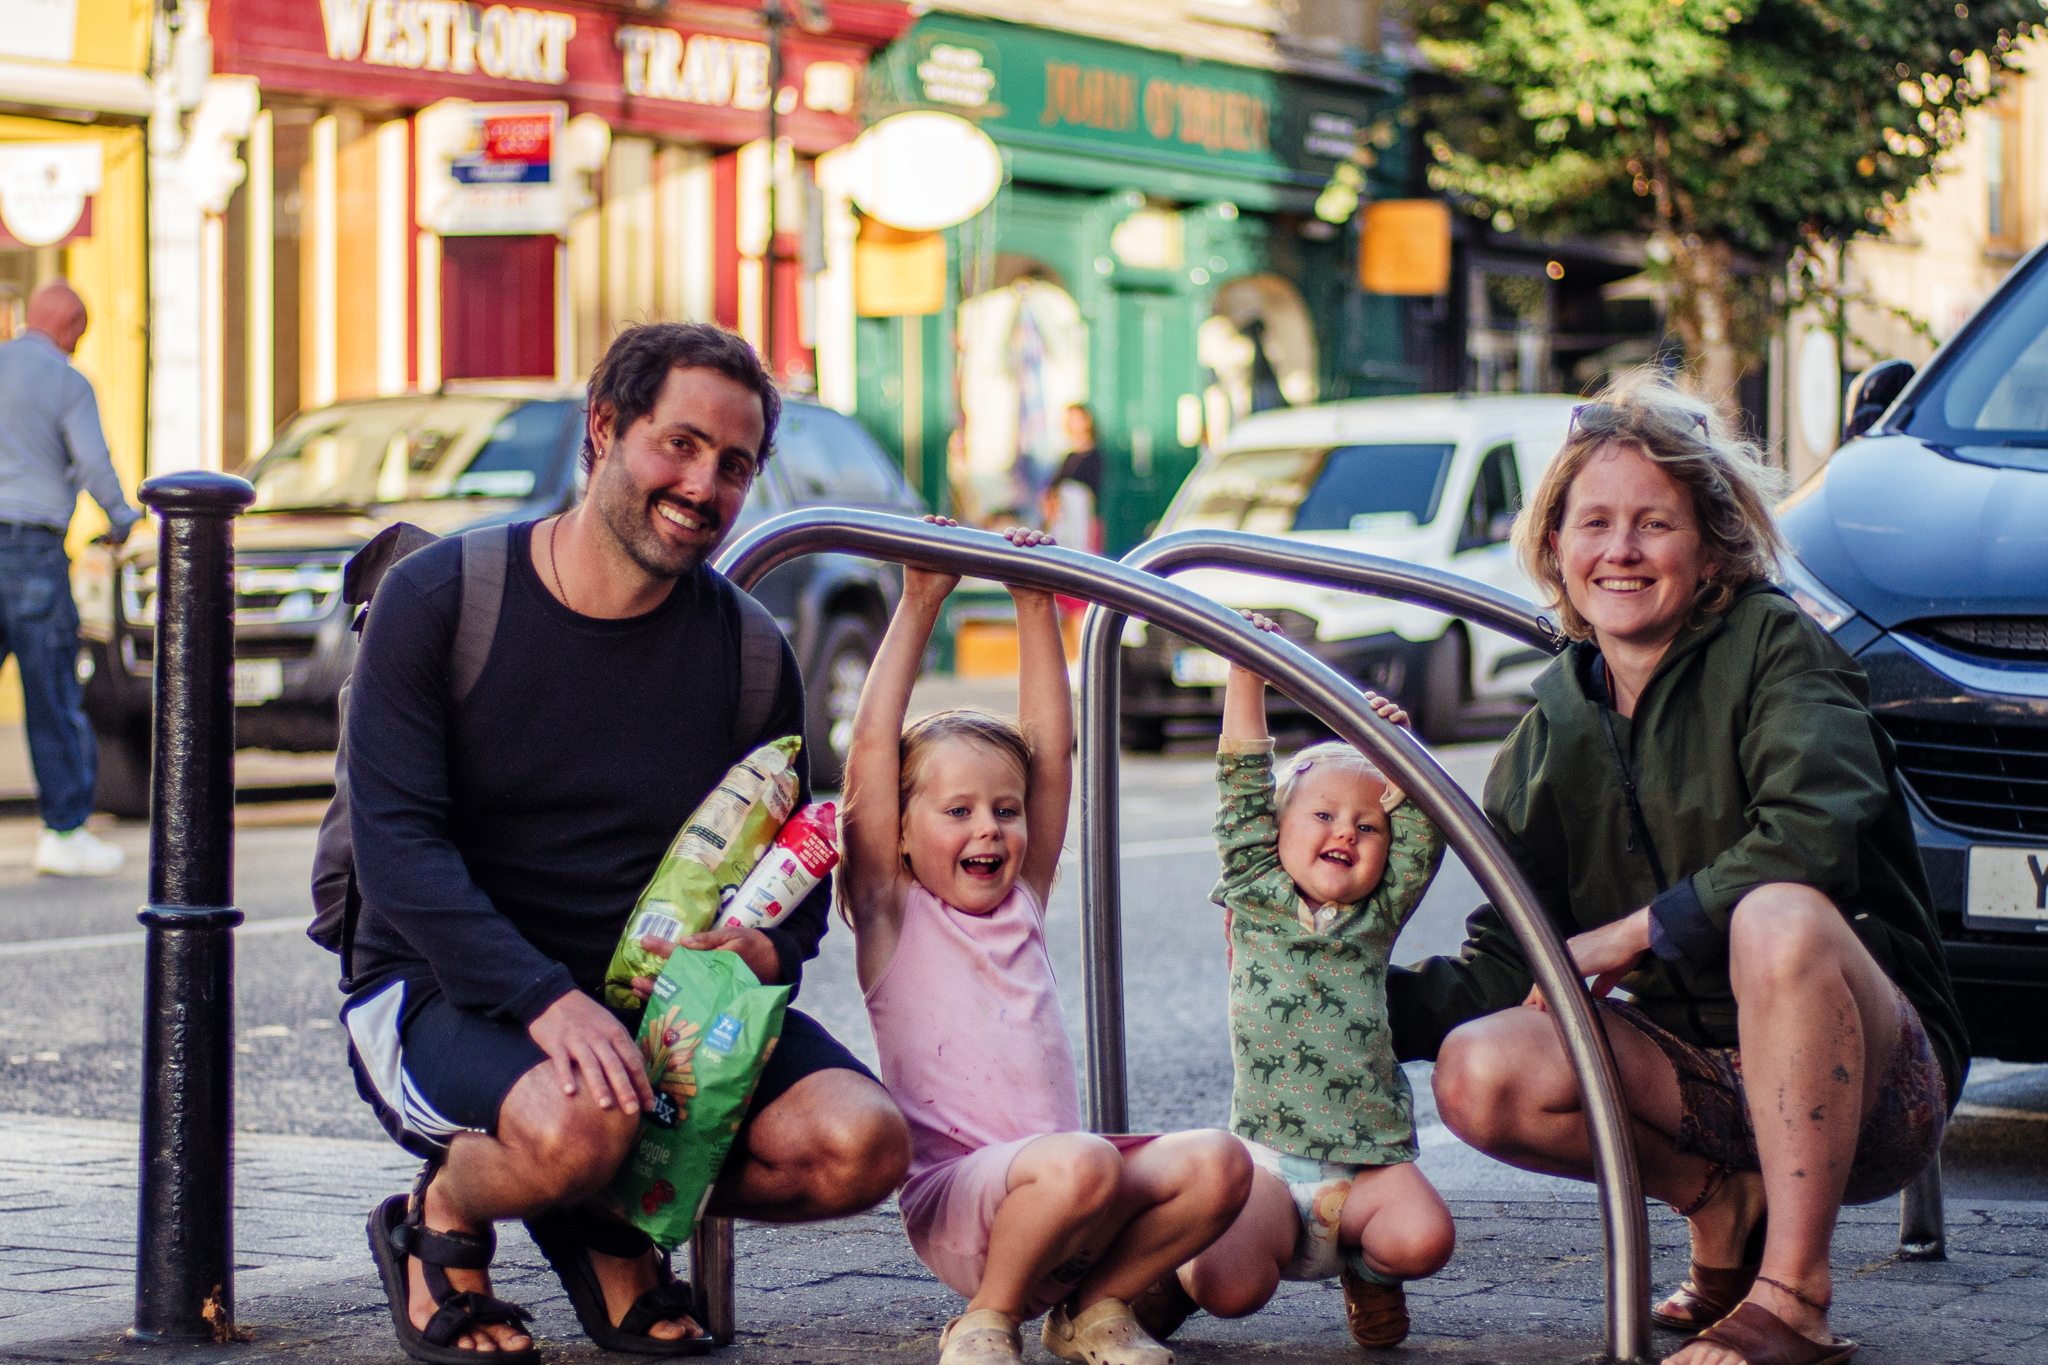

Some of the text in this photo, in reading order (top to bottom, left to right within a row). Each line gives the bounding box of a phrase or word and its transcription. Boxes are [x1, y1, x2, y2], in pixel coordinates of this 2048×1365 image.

[614, 24, 798, 115] TRAVE
[802, 840, 811, 848] GOT
[811, 832, 819, 840] FOR
[2027, 855, 2048, 909] Y
[718, 1018, 734, 1032] 7+
[640, 1139, 670, 1165] eggie
